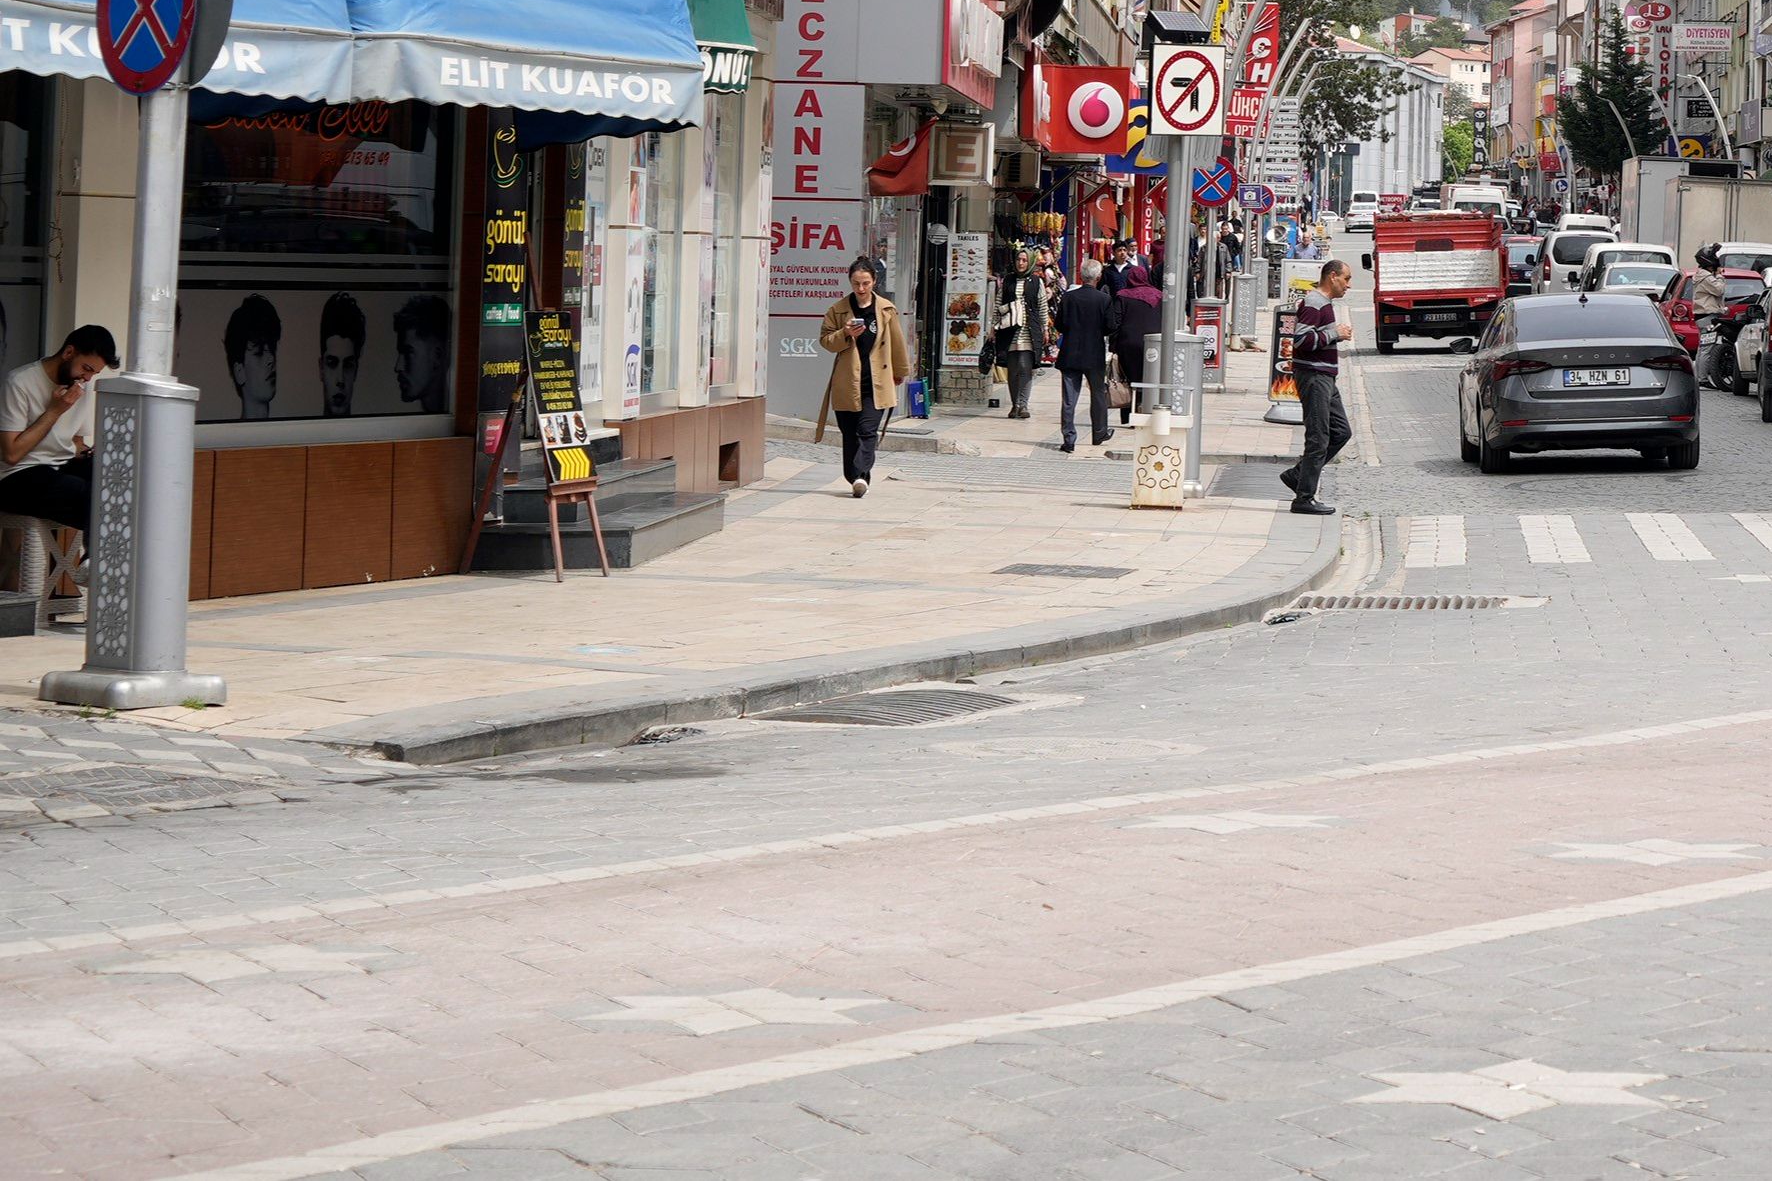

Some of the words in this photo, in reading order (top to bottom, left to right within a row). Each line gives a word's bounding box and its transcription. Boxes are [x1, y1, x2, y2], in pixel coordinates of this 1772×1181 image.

[1686, 28, 1731, 39] DİYETİSYEN
[702, 46, 749, 84] ÖNÜL
[440, 56, 508, 90] ELİT
[522, 64, 676, 106] KUAFÖR
[486, 209, 527, 255] gönül
[770, 216, 846, 255] ŞİFA
[484, 263, 525, 293] sarayı
[778, 277, 794, 286] TÜM
[796, 278, 839, 287] KURUMLARIN
[769, 289, 803, 299] EÇETELERİ
[804, 290, 845, 300] KARŞILANIR
[780, 338, 818, 354] SGK
[1570, 370, 1582, 382] 34
[1589, 370, 1608, 381] HZN
[1615, 370, 1627, 381] 61
